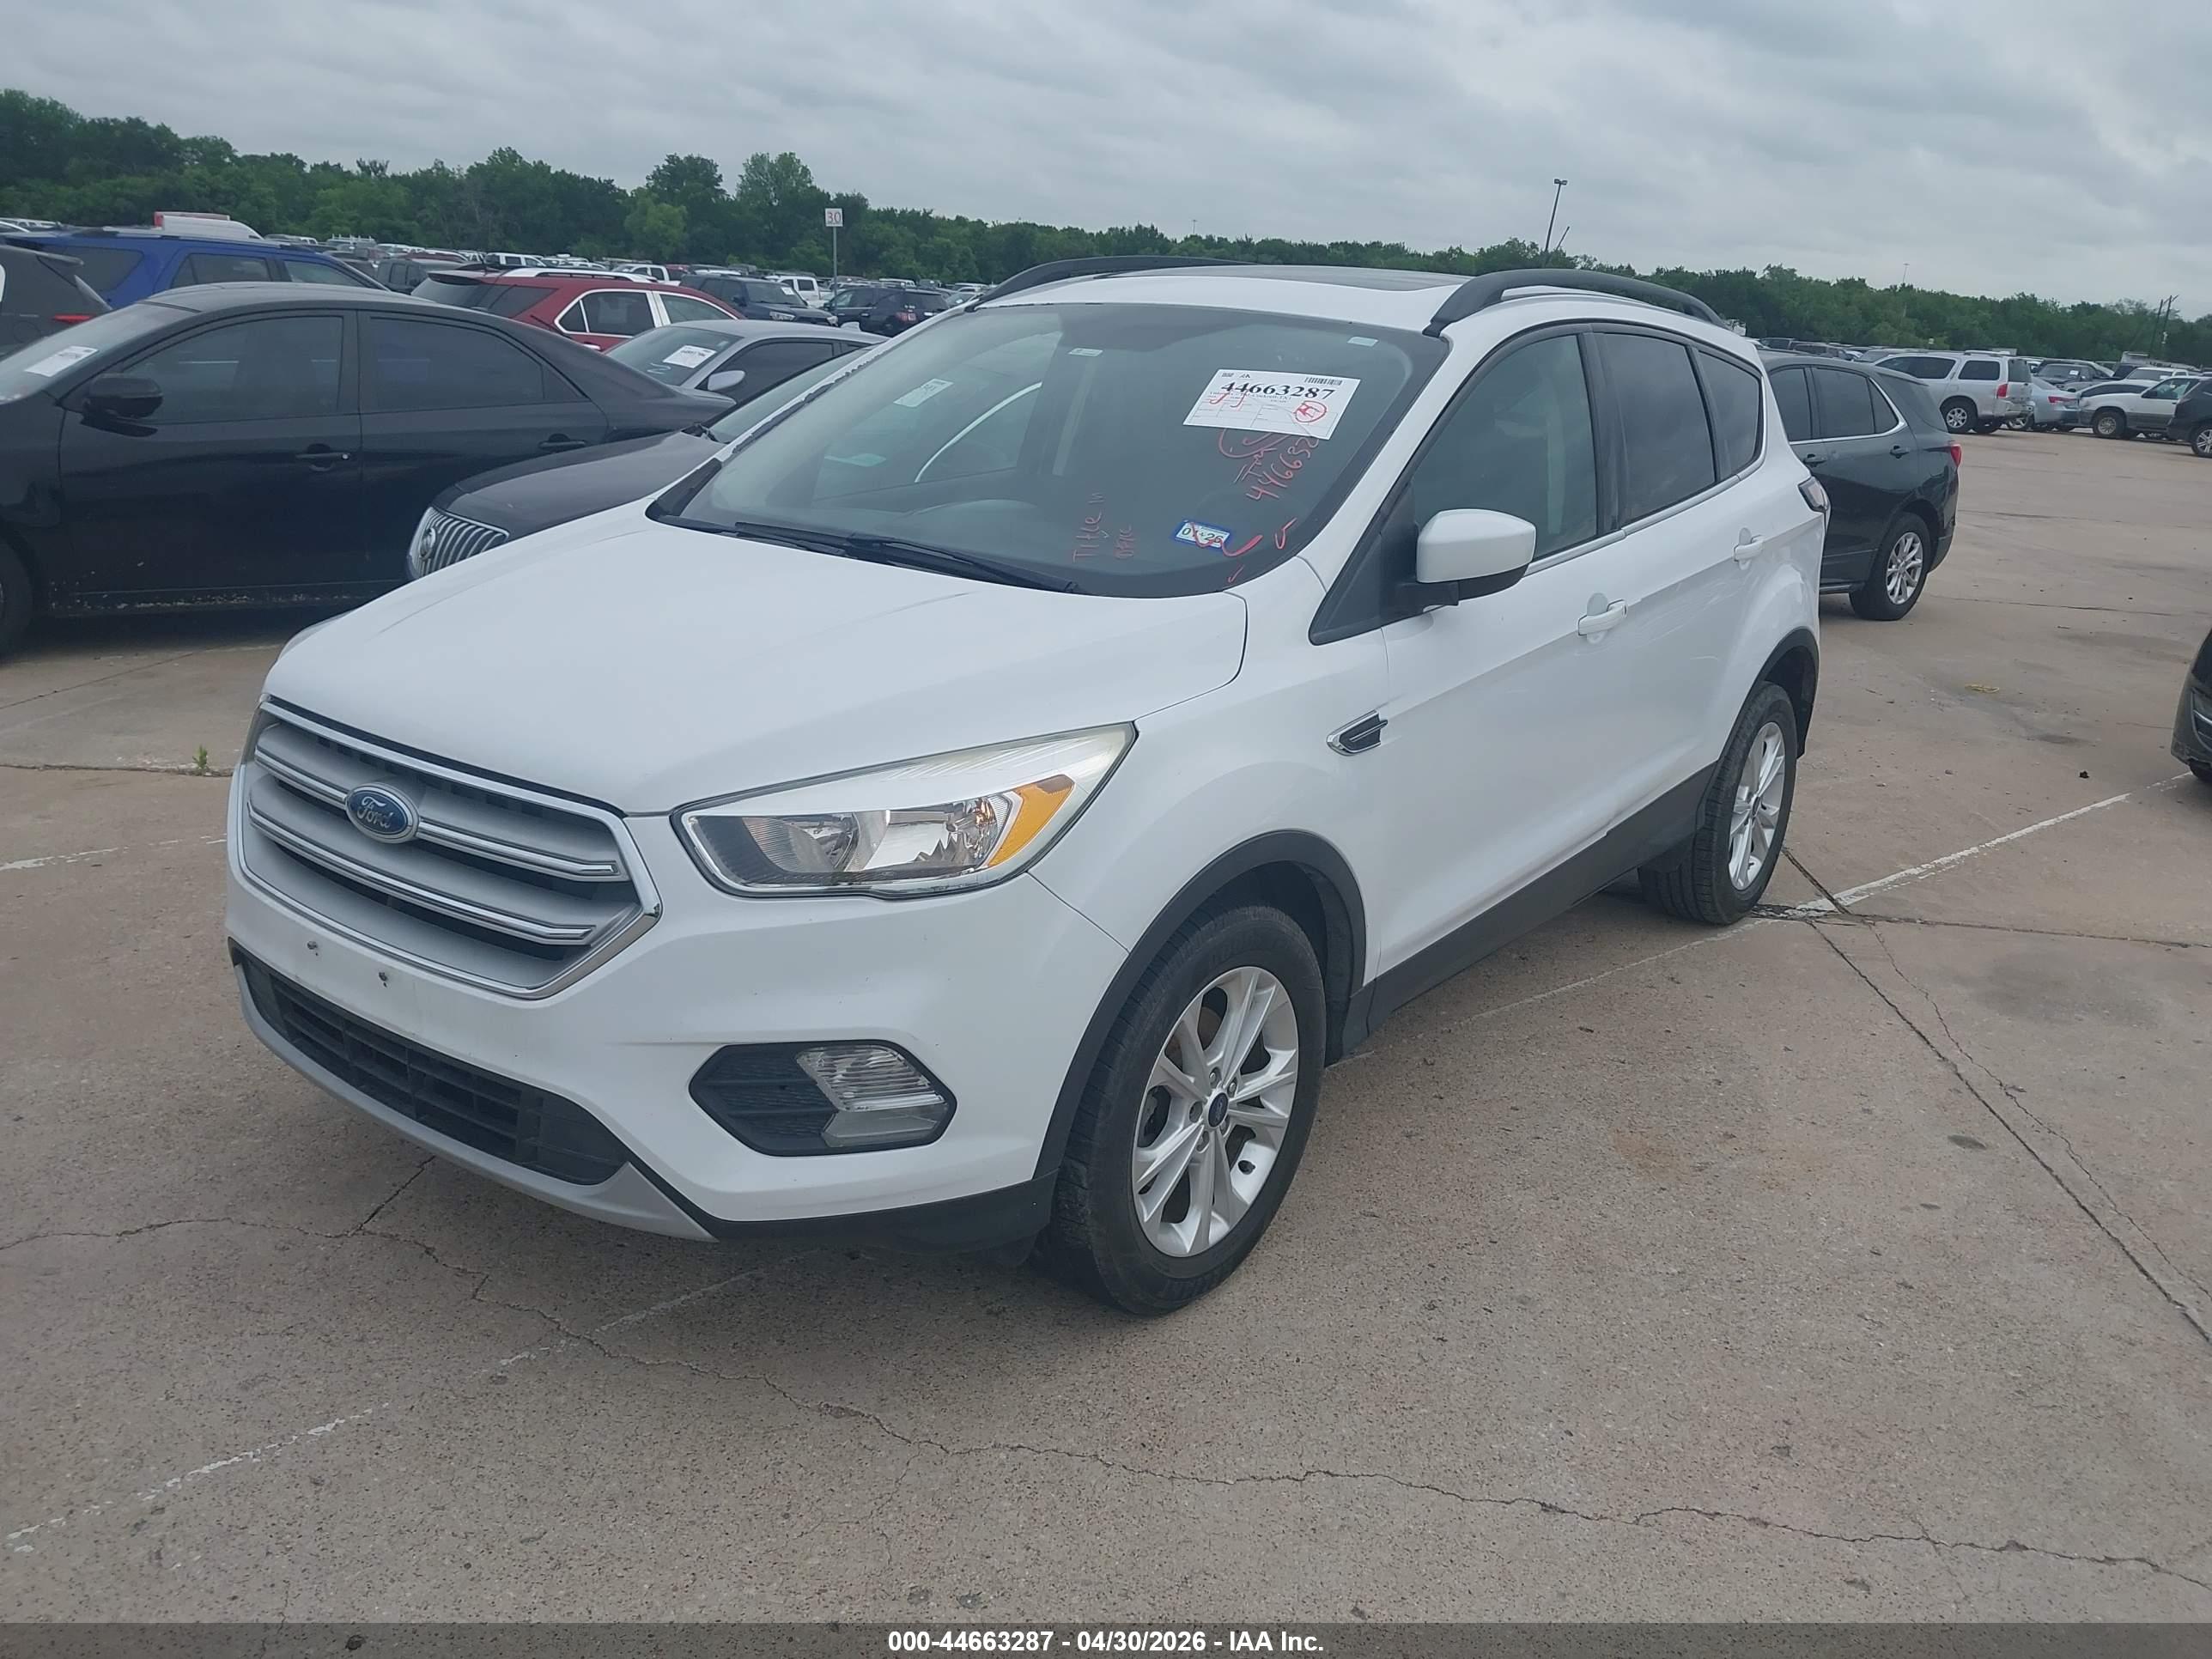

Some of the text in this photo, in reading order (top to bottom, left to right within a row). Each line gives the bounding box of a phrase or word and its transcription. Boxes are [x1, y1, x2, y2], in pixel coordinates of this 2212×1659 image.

[827, 212, 842, 224] 30
[1220, 380, 1336, 400] 44663287
[356, 795, 394, 830] Ford
